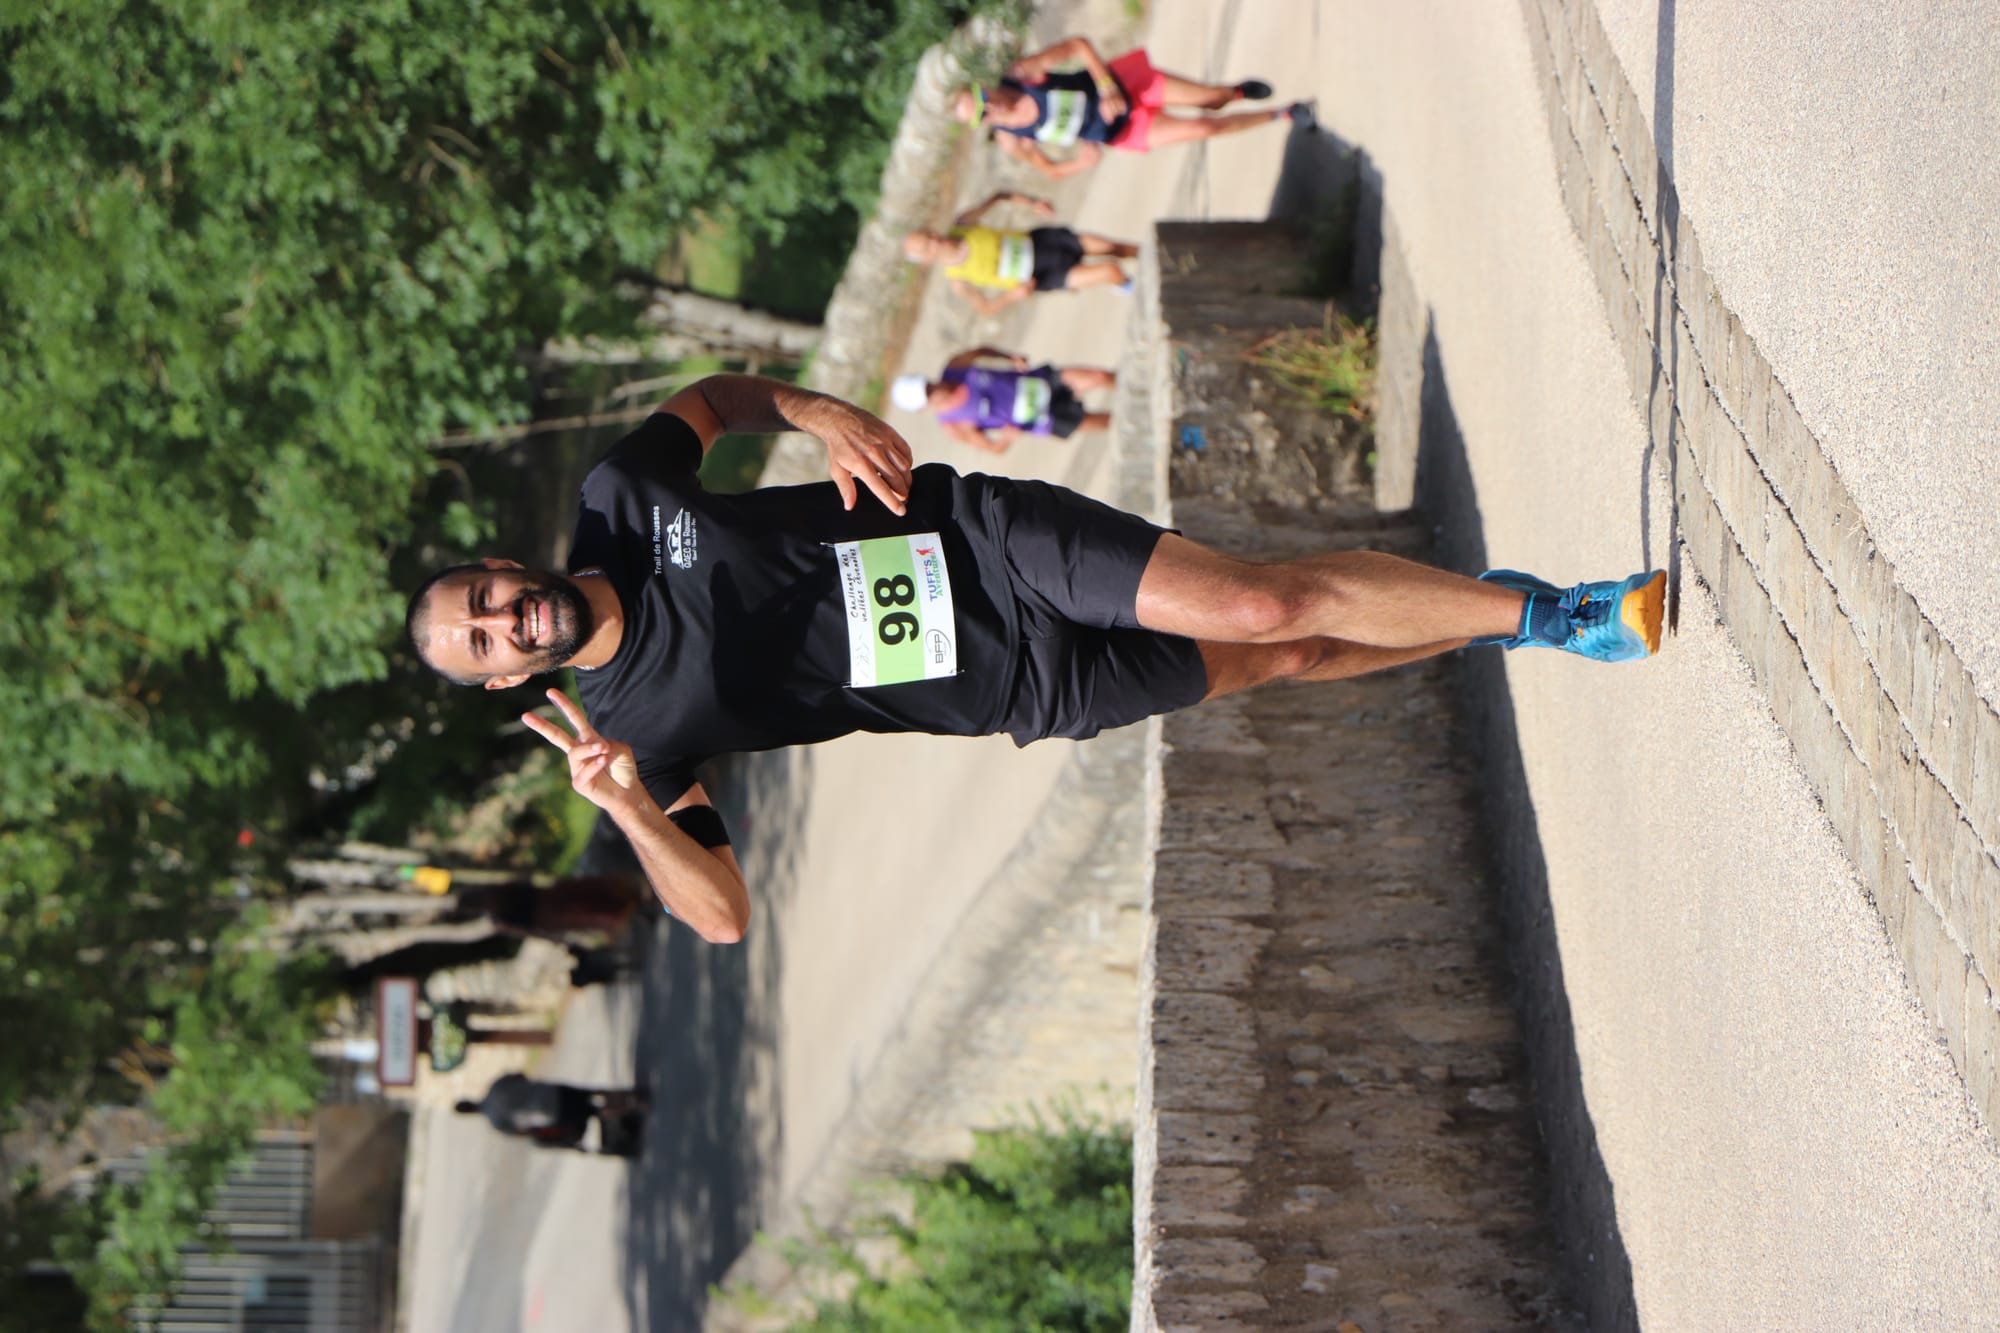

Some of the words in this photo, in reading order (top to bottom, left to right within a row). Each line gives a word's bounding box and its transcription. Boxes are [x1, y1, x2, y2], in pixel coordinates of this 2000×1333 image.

[652, 505, 661, 542] Rousses
[653, 544, 661, 555] de
[653, 556, 662, 575] Trail
[841, 553, 850, 568] des
[848, 548, 863, 585] cévenoles
[930, 554, 944, 597] Aventure
[846, 572, 859, 618] Challenge
[856, 590, 868, 622] vallées
[873, 574, 920, 646] 98
[933, 633, 944, 664] BFP
